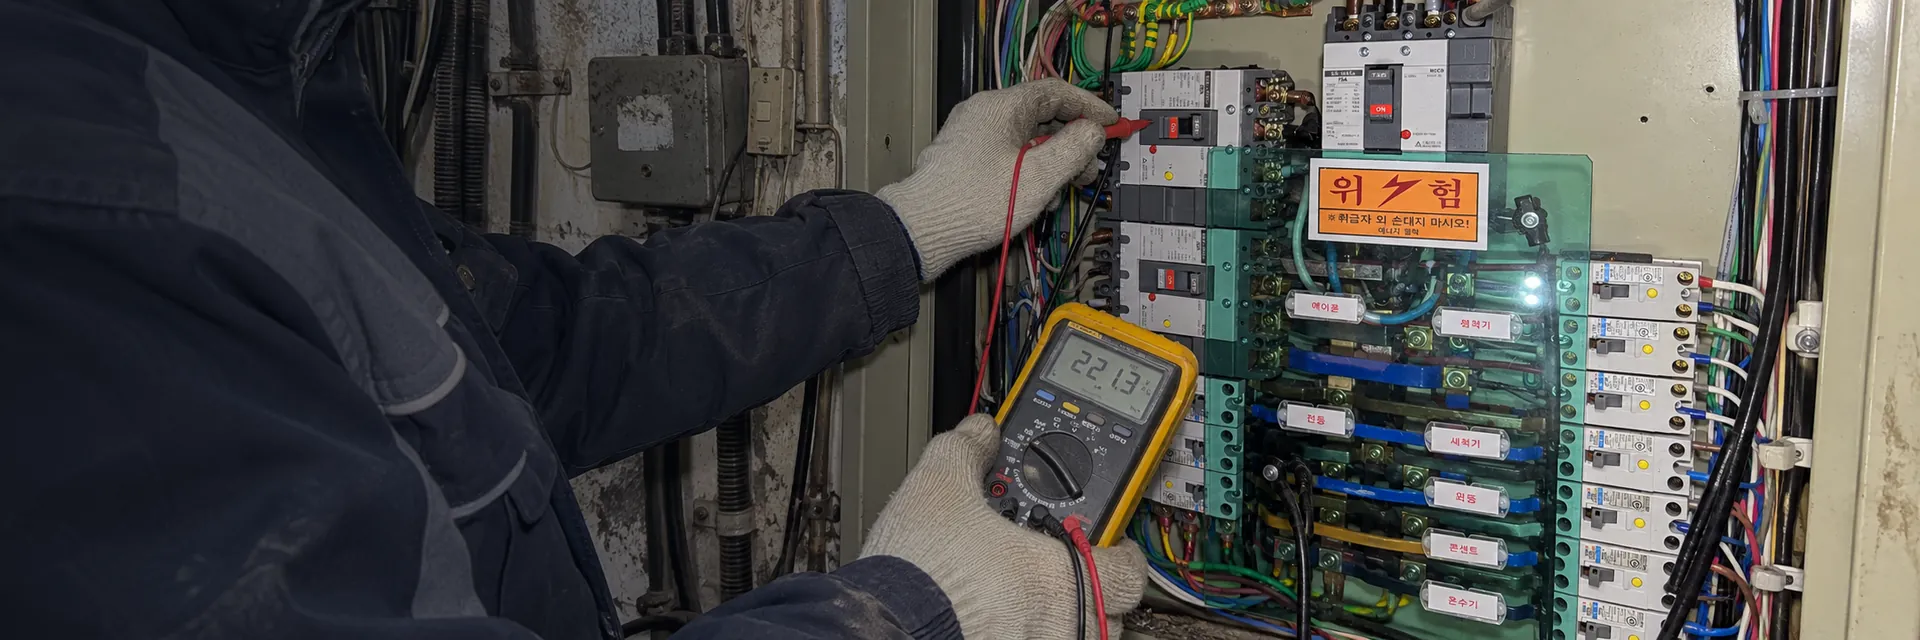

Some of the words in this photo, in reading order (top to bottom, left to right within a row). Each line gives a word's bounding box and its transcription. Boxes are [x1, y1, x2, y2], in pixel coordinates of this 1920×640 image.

[1329, 174, 1363, 206] 위
[1428, 178, 1461, 209] 험
[1376, 215, 1387, 225] 외
[1392, 215, 1426, 227] 손대지
[1431, 217, 1470, 229] 마시오!
[1070, 350, 1141, 395] 221.3
[1449, 543, 1478, 555] 콘센트
[1447, 595, 1478, 610] 온수기
